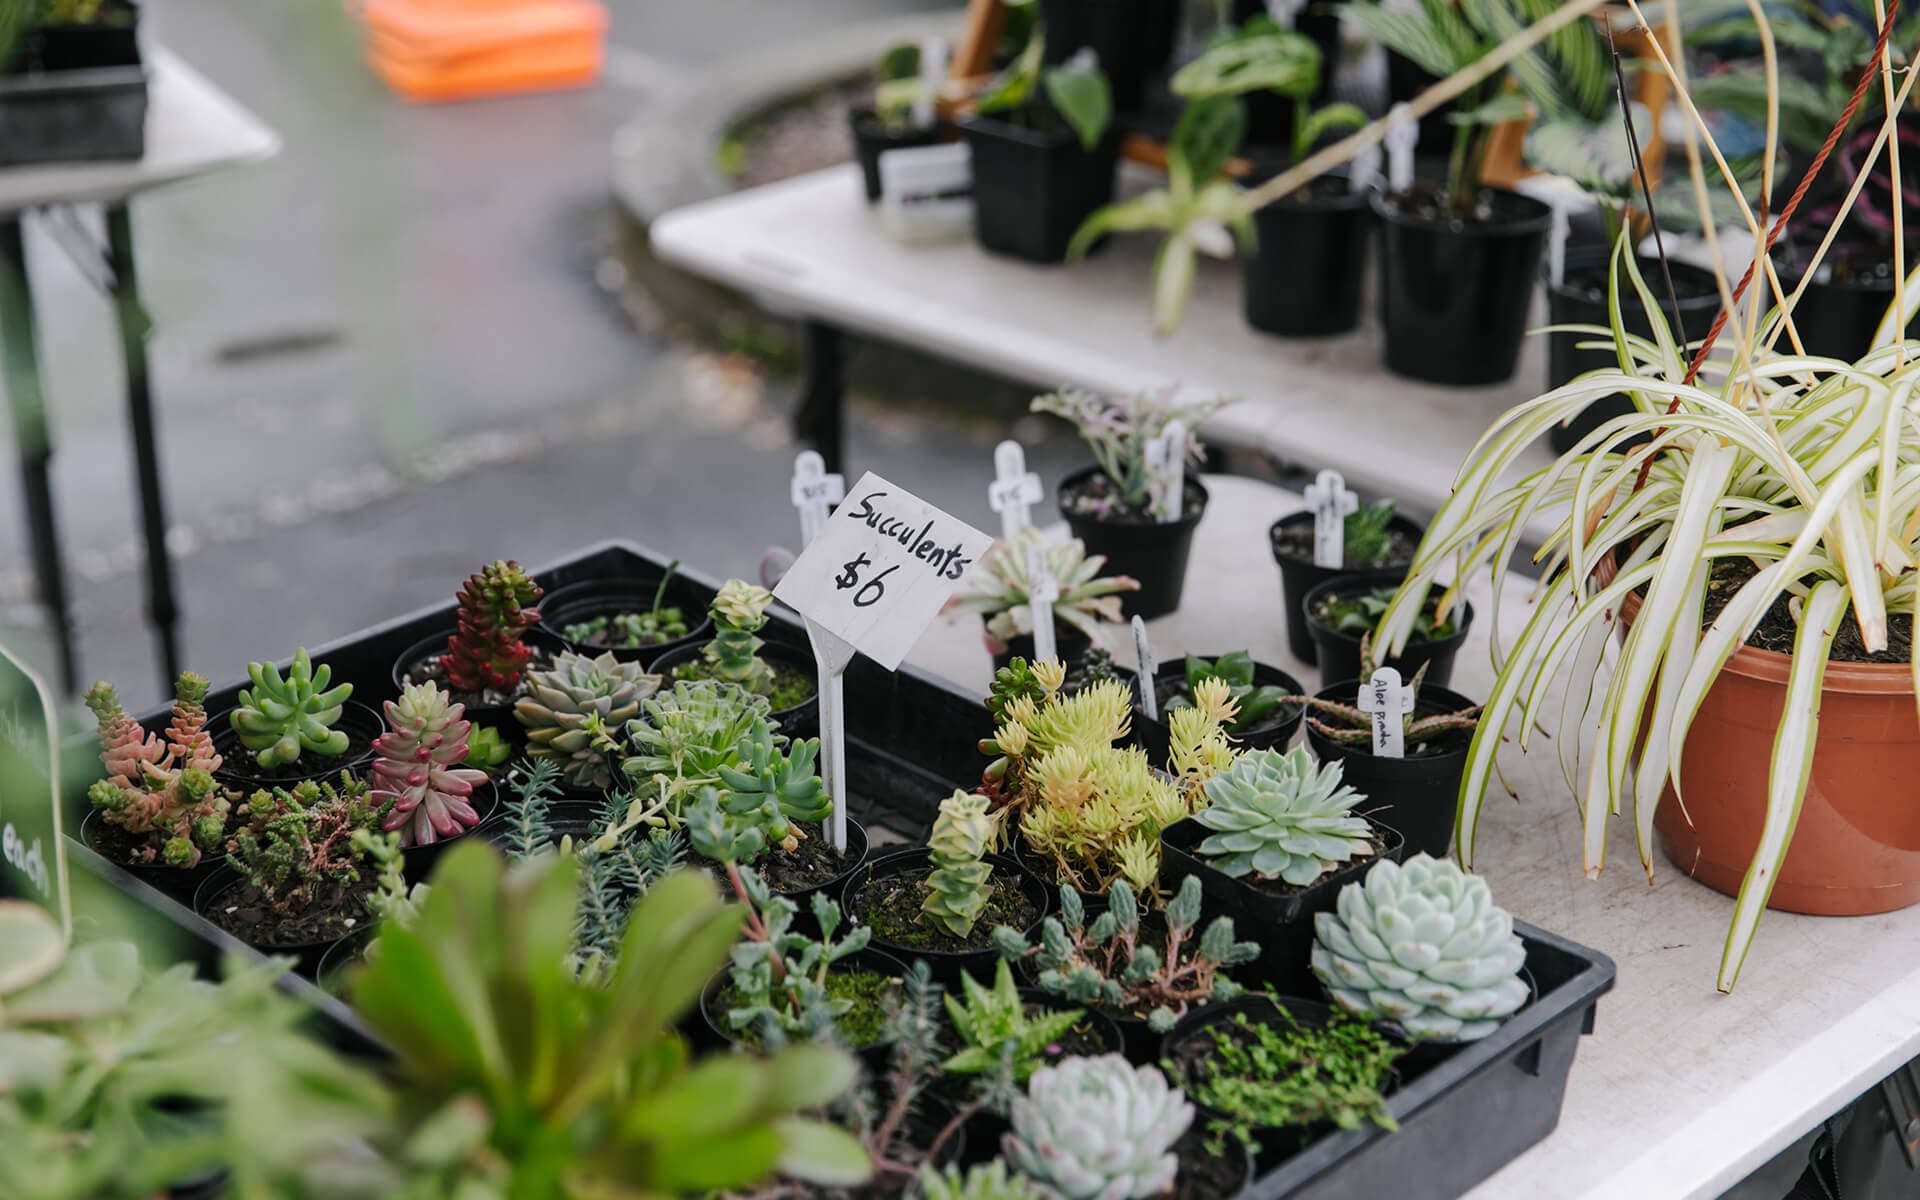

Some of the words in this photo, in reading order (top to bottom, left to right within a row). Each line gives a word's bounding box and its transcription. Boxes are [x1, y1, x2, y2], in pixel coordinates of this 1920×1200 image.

[848, 492, 972, 580] Succulents
[834, 552, 900, 607] $6
[1374, 679, 1388, 706] Aloe
[2, 822, 50, 899] each
